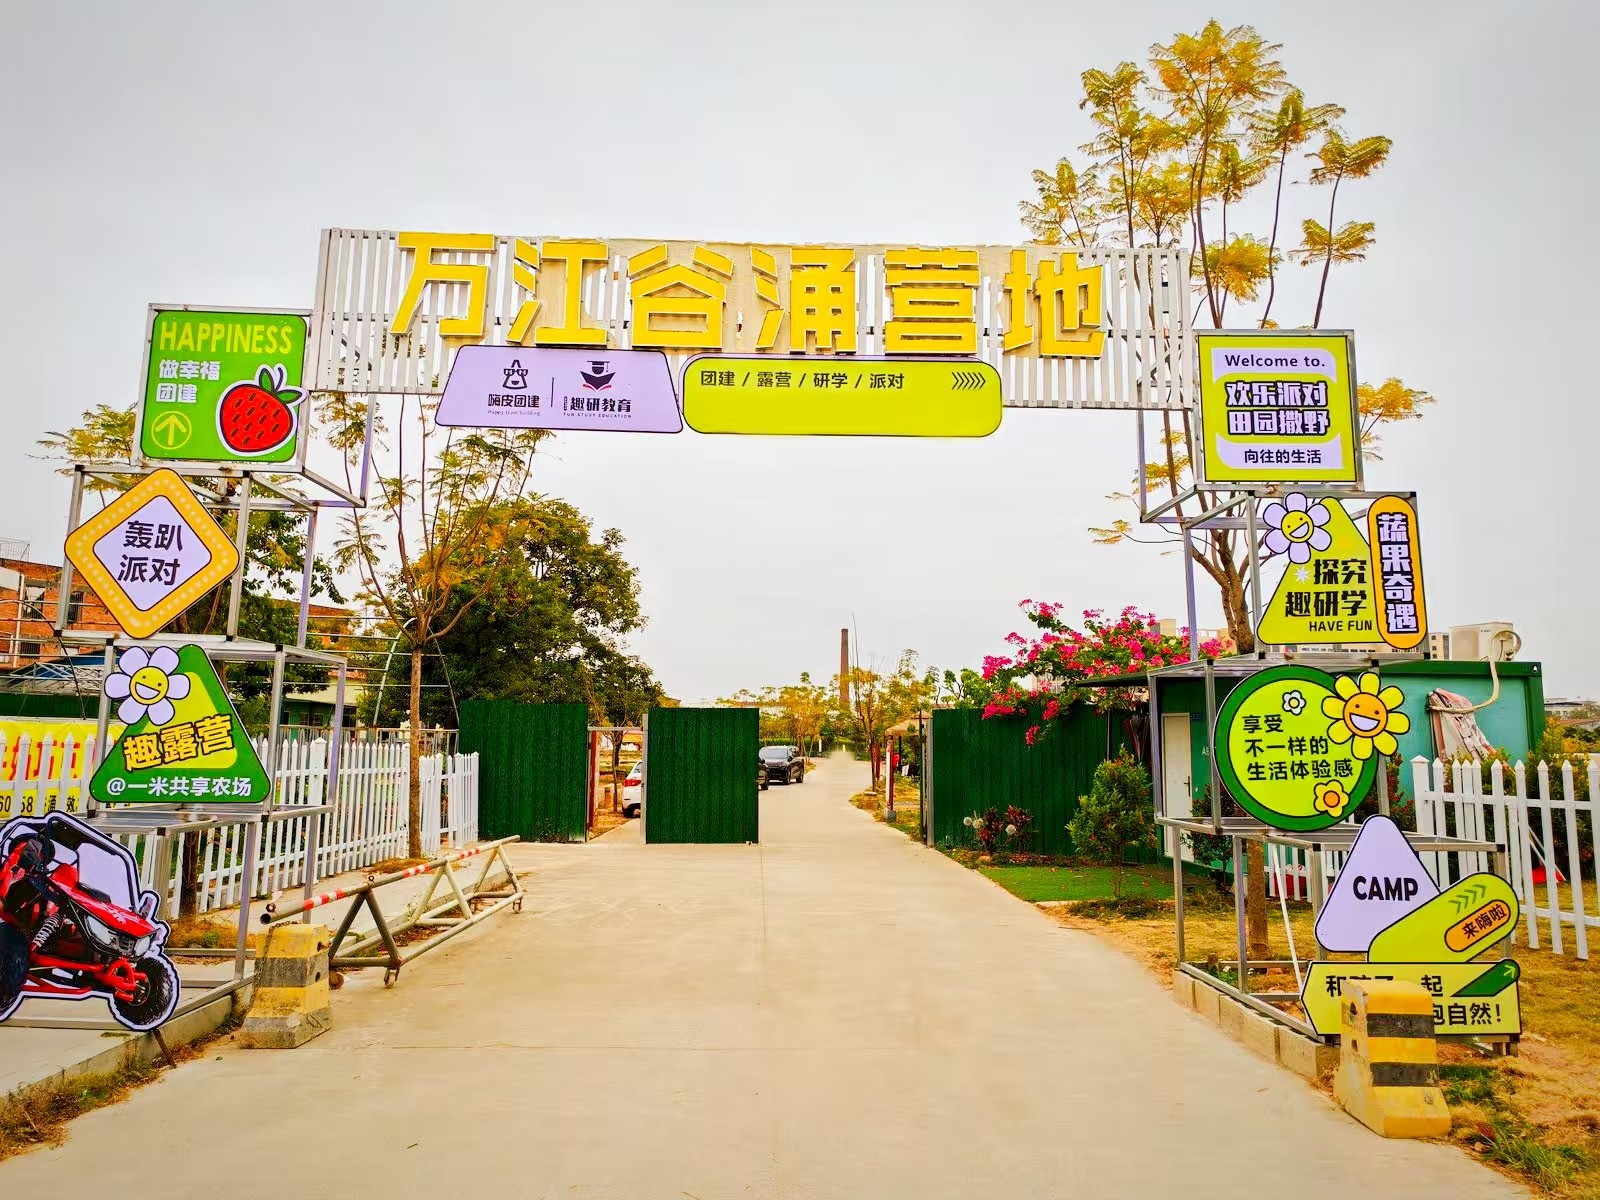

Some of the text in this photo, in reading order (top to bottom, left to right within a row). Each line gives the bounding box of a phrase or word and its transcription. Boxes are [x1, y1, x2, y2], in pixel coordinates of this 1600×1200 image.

[390, 231, 1106, 358] 万江谷涌营地
[159, 321, 293, 355] HAPPINESS
[159, 359, 221, 381] 做幸福
[1225, 354, 1326, 367] Welcome to.
[156, 382, 198, 404] 团建
[488, 393, 540, 408] 嗨皮团建
[570, 397, 632, 412] 趣研教育
[1225, 381, 1327, 407] 欢乐派对
[1228, 409, 1330, 435] 田园撒野
[1244, 449, 1322, 464] 向往的生活
[123, 520, 183, 551] 轰趴
[117, 554, 181, 586] 派对
[1313, 559, 1367, 585] 探究
[1377, 512, 1419, 634] 蔬果奇遇
[1285, 590, 1367, 617] 趣研学
[1309, 620, 1373, 632] HAVE FUN
[1242, 714, 1284, 734] 享受
[123, 713, 234, 772] 趣露营
[1245, 736, 1328, 758] 不一样的
[1247, 759, 1353, 781] 生活体验感
[106, 776, 252, 796] @一米共享农场
[1353, 875, 1419, 902] CAMP
[1461, 903, 1508, 940] 来嗨啦
